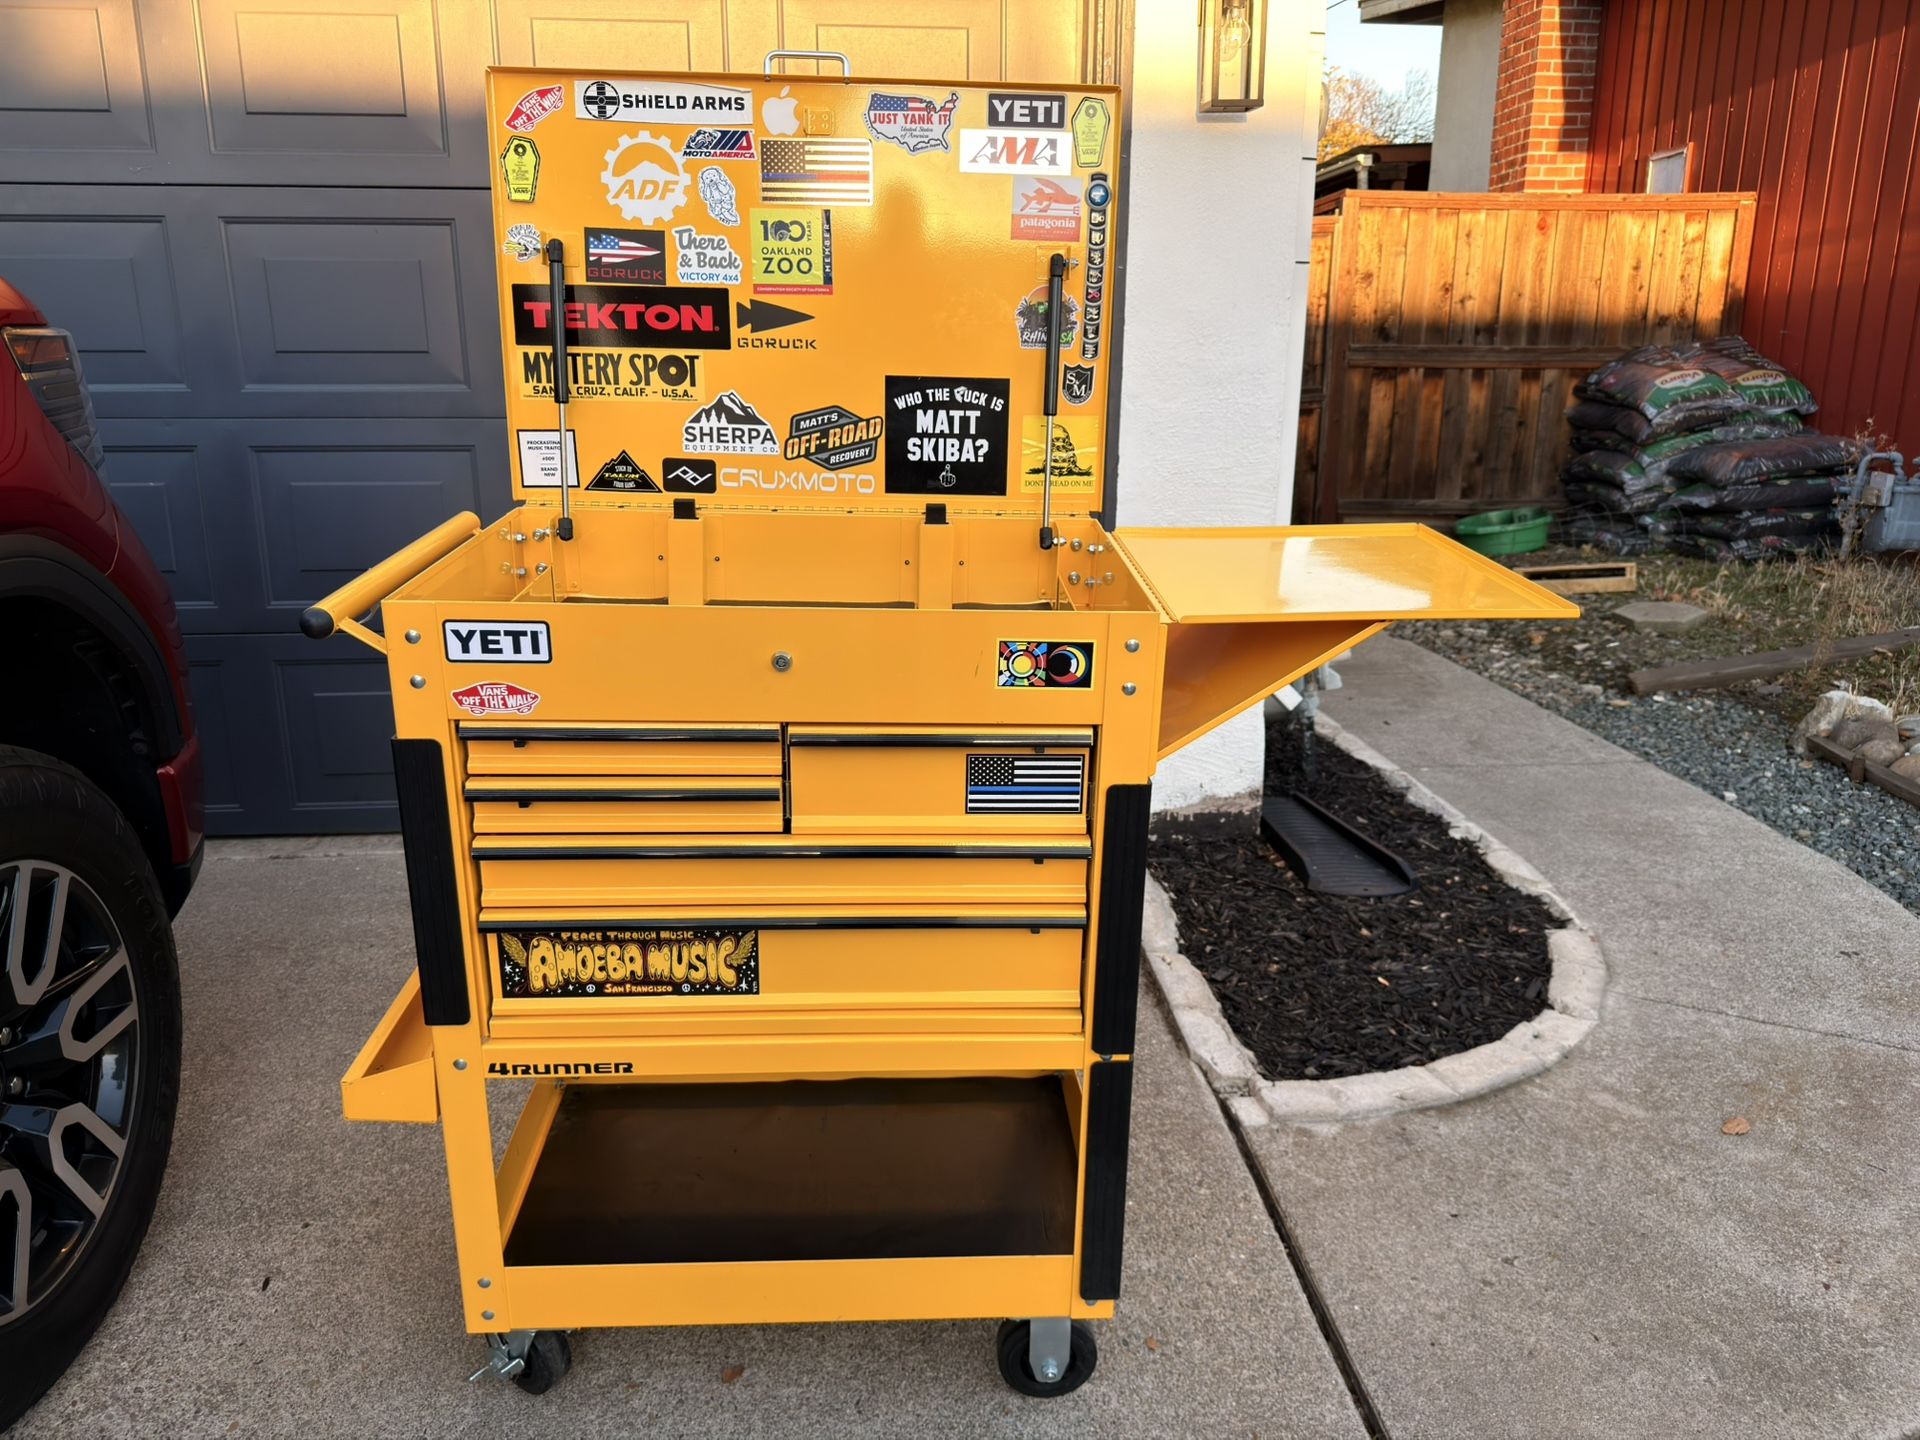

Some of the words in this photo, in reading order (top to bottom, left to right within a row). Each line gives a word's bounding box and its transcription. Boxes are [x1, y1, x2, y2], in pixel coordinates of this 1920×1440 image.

[518, 92, 541, 112] VANS
[526, 102, 546, 120] THE
[622, 94, 689, 110] SHIELD
[692, 96, 746, 112] ARMS
[872, 112, 898, 124] JUST
[903, 113, 934, 125] YANK
[938, 114, 948, 125] IT
[992, 100, 1058, 124] YETI
[682, 150, 756, 159] MOTOAMERICA
[968, 136, 1060, 166] AMA
[612, 180, 679, 201] ADF
[760, 220, 806, 242] 100
[1020, 217, 1076, 229] patagonia
[674, 228, 727, 250] There
[679, 253, 692, 268] &
[696, 251, 741, 269] Back
[761, 247, 813, 255] OAKLAND
[588, 267, 664, 280] GORUCK
[762, 257, 813, 274] ZOO
[679, 272, 721, 281] VICTORY
[524, 301, 716, 332] TEKTON
[737, 337, 817, 350] GORUCK
[522, 352, 623, 385] MYTERY
[628, 354, 700, 387] SPOT
[1660, 371, 1701, 385] Vigoro
[1742, 372, 1782, 382] Vigoro
[576, 386, 610, 397] CRUZ,
[614, 387, 648, 397] CALIF.
[661, 388, 693, 398] U.S.A.
[894, 391, 922, 410] WHO
[926, 388, 950, 402] THE
[990, 396, 1004, 412] IS
[800, 412, 838, 429] MATT'S
[916, 409, 980, 435] MATT
[684, 426, 777, 445] SHERPA
[786, 418, 882, 459] OFF-ROAD
[830, 447, 870, 464] RECOVERY
[907, 437, 989, 463] SKIBA?
[720, 467, 876, 494] CRUXMOTO
[450, 629, 540, 655] YETI
[477, 685, 508, 696] VANS
[482, 695, 506, 708] THE
[561, 932, 603, 941] PEACE
[606, 931, 656, 940] THROUGH
[659, 931, 694, 940] MUSIC
[529, 938, 643, 993] AMOEBA
[648, 937, 738, 986] MUSIC
[604, 984, 624, 992] SAN
[488, 1063, 634, 1075] 4RUNNER
